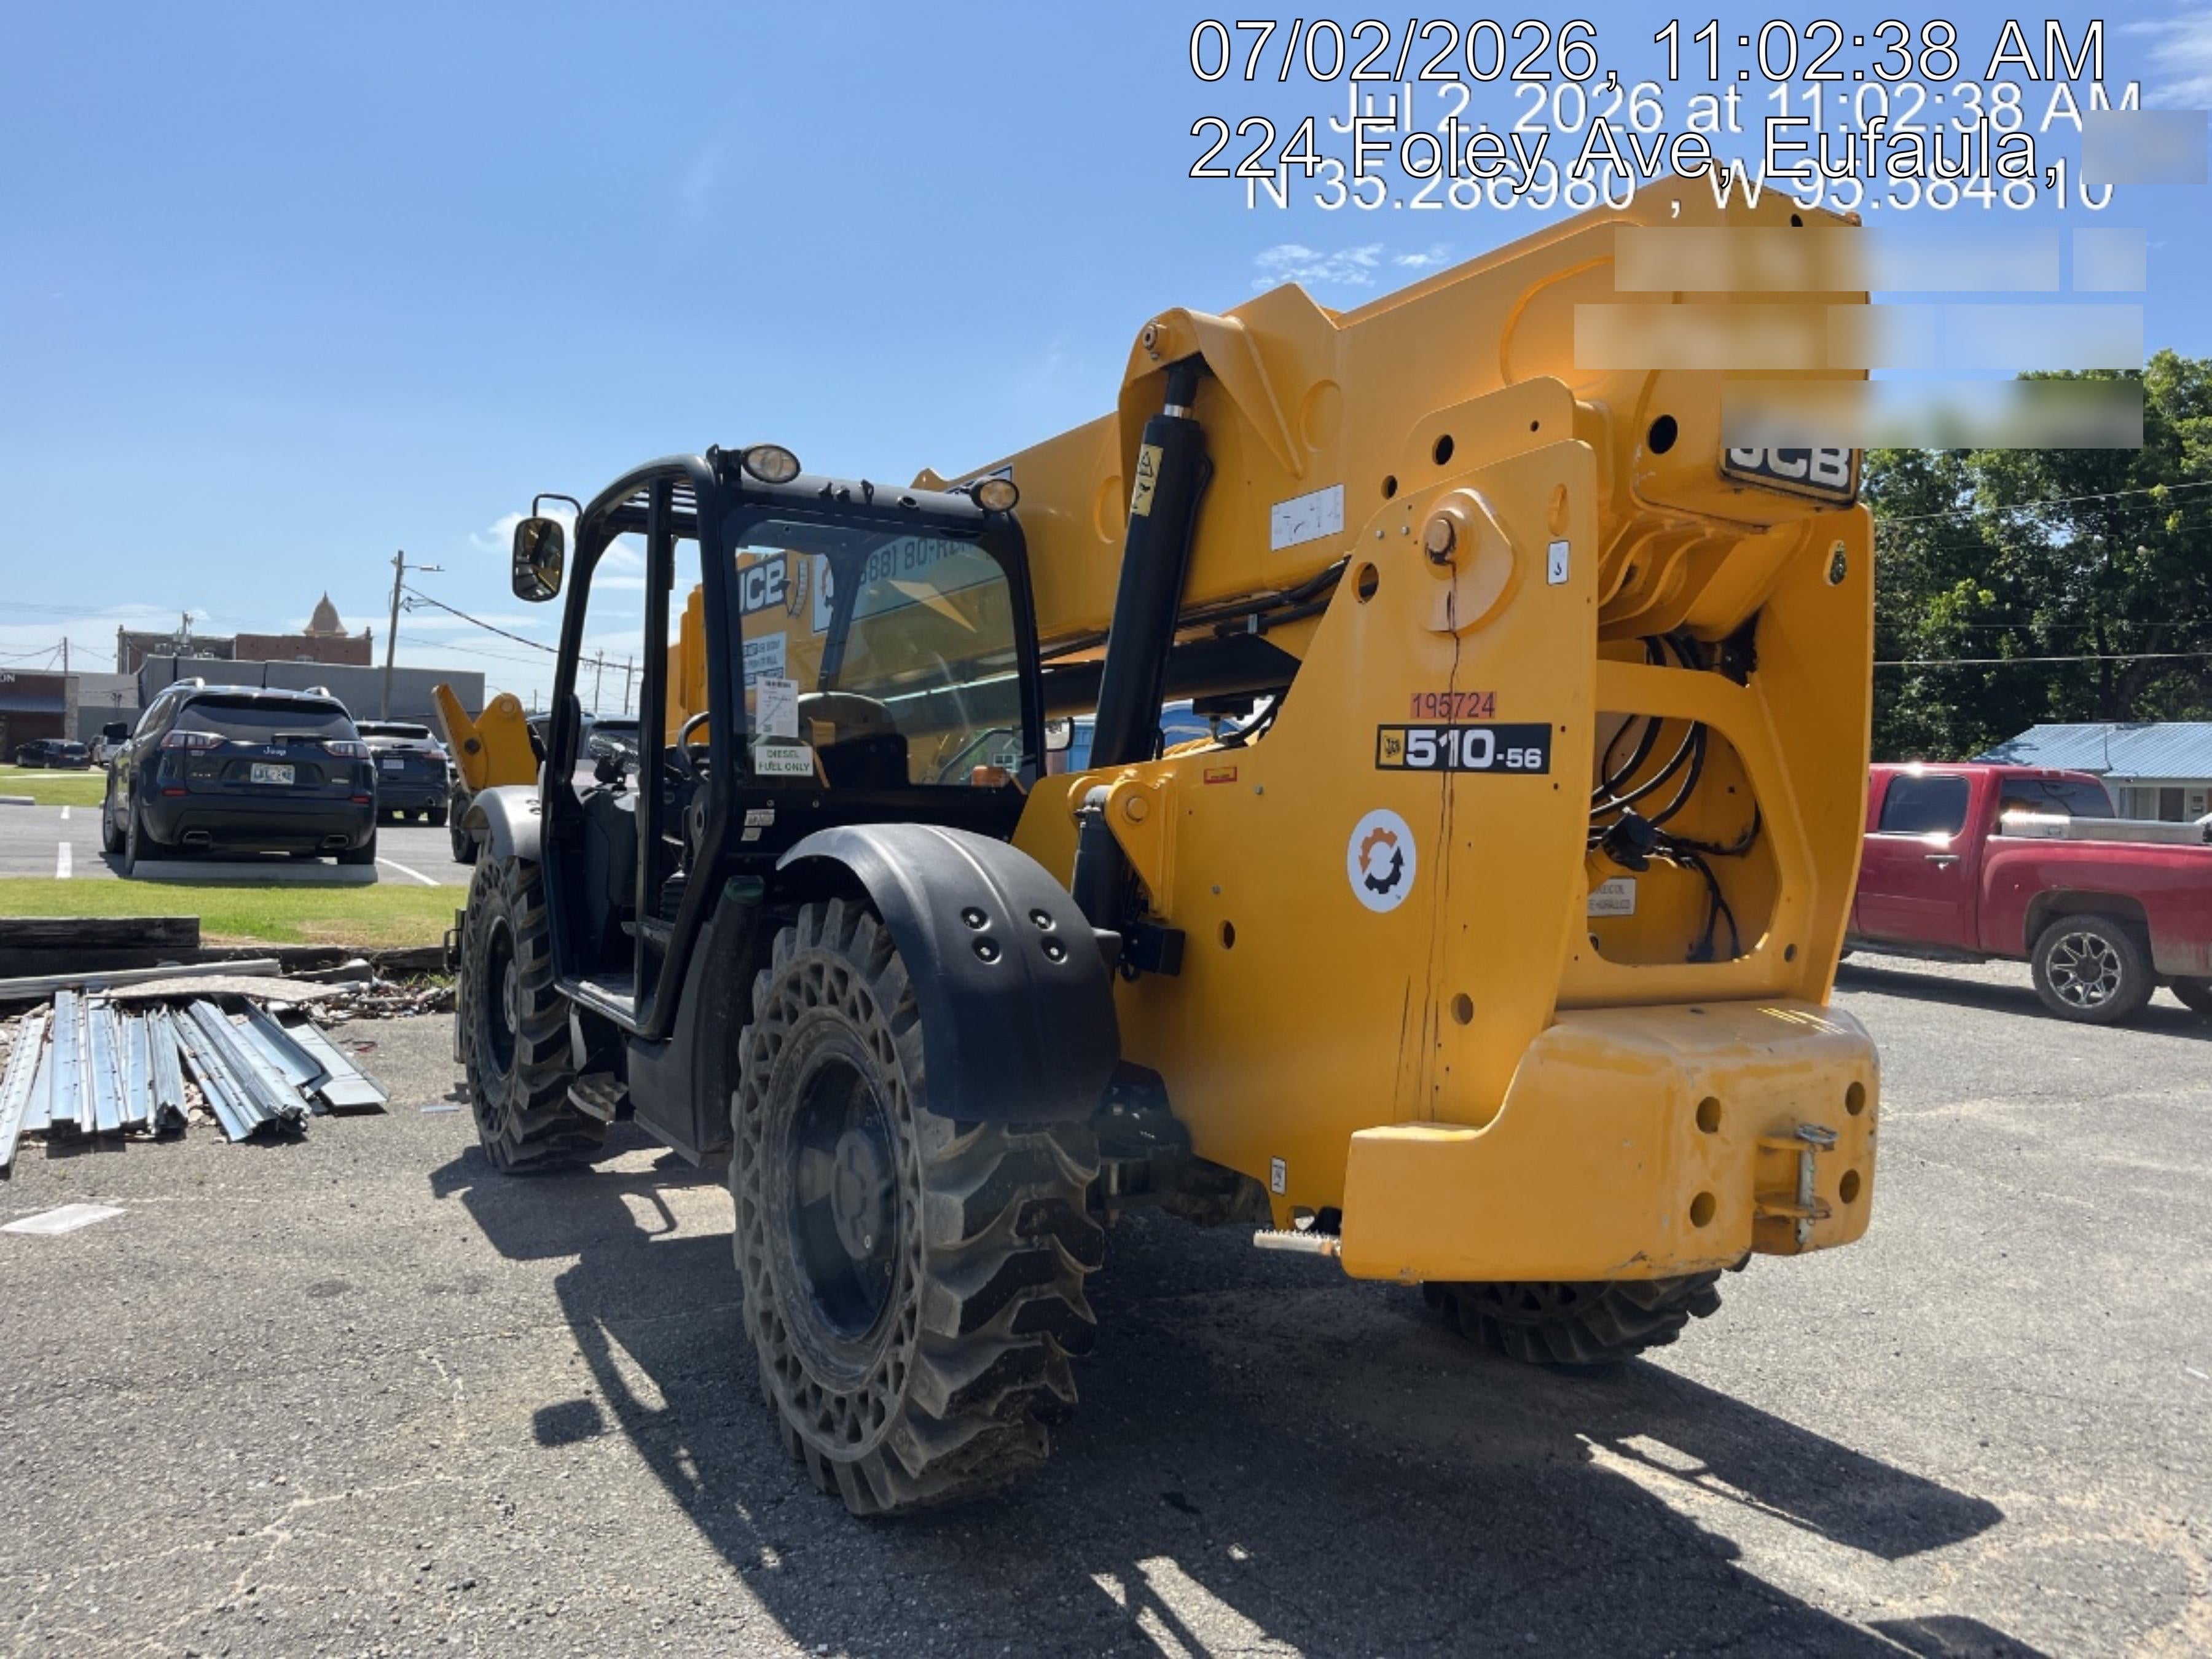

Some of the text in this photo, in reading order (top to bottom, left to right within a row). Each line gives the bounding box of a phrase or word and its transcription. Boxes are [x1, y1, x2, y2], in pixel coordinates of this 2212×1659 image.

[1413, 692, 1495, 718] 195724
[767, 750, 800, 759] DIESEL
[758, 761, 810, 771] FUEL ONLY
